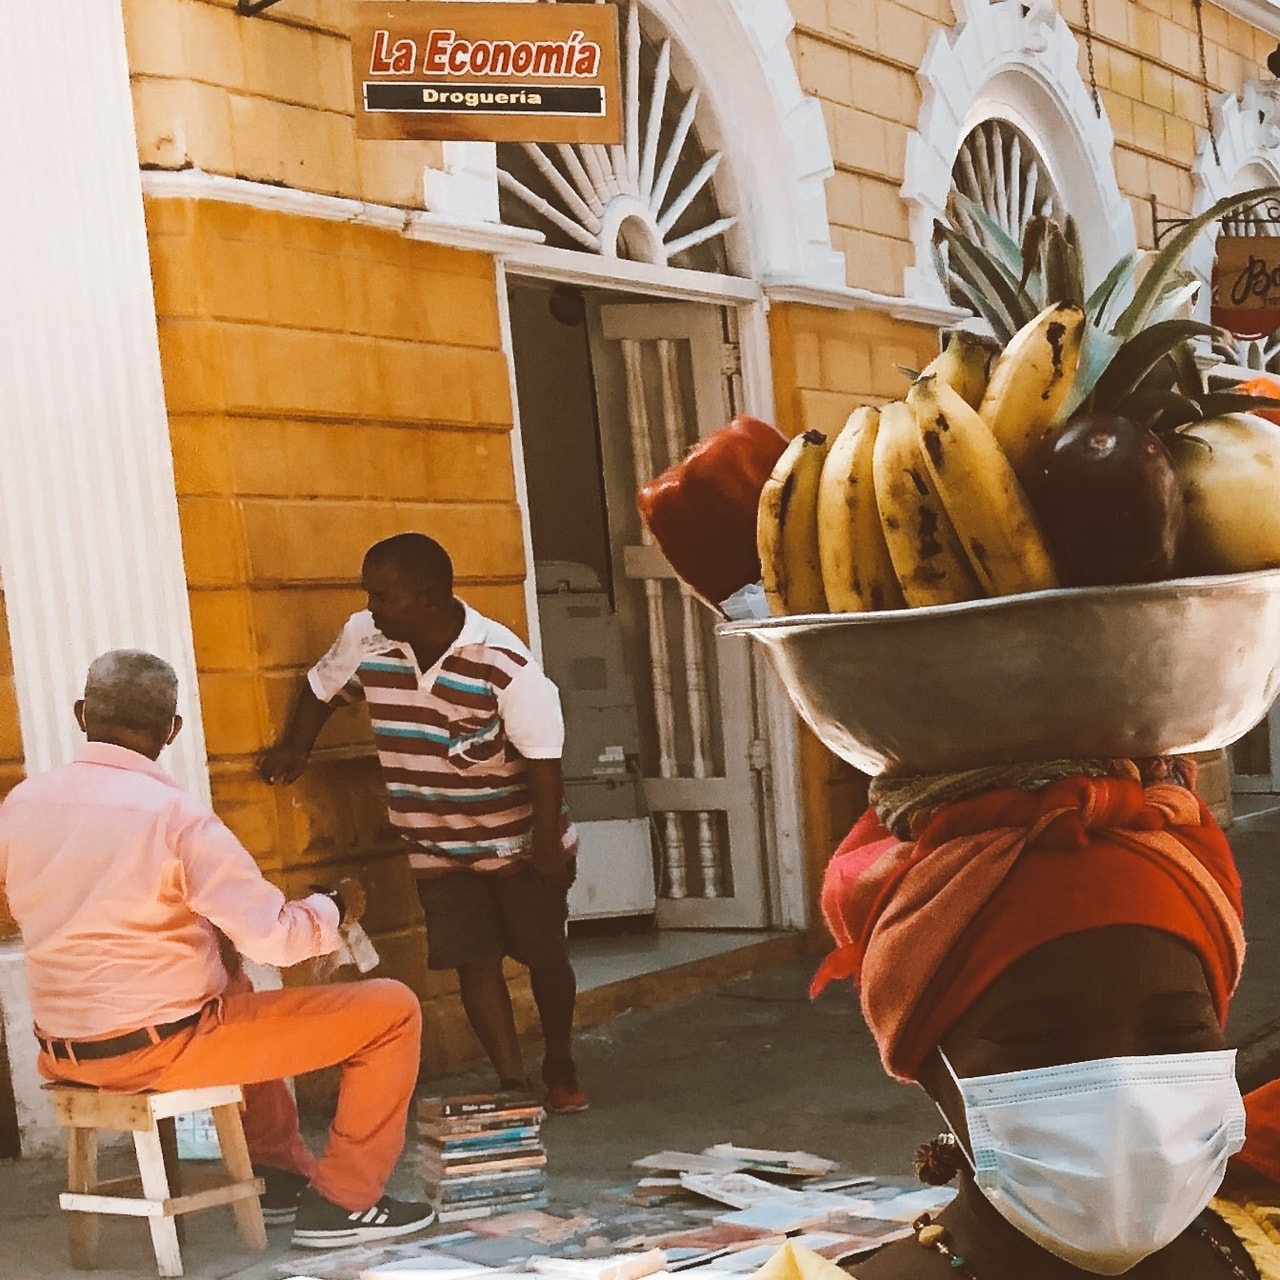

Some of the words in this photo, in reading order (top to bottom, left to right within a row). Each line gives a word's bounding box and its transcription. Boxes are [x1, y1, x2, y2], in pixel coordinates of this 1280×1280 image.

[369, 29, 416, 76] La
[423, 29, 600, 77] Economía
[422, 89, 542, 107] Droguería
